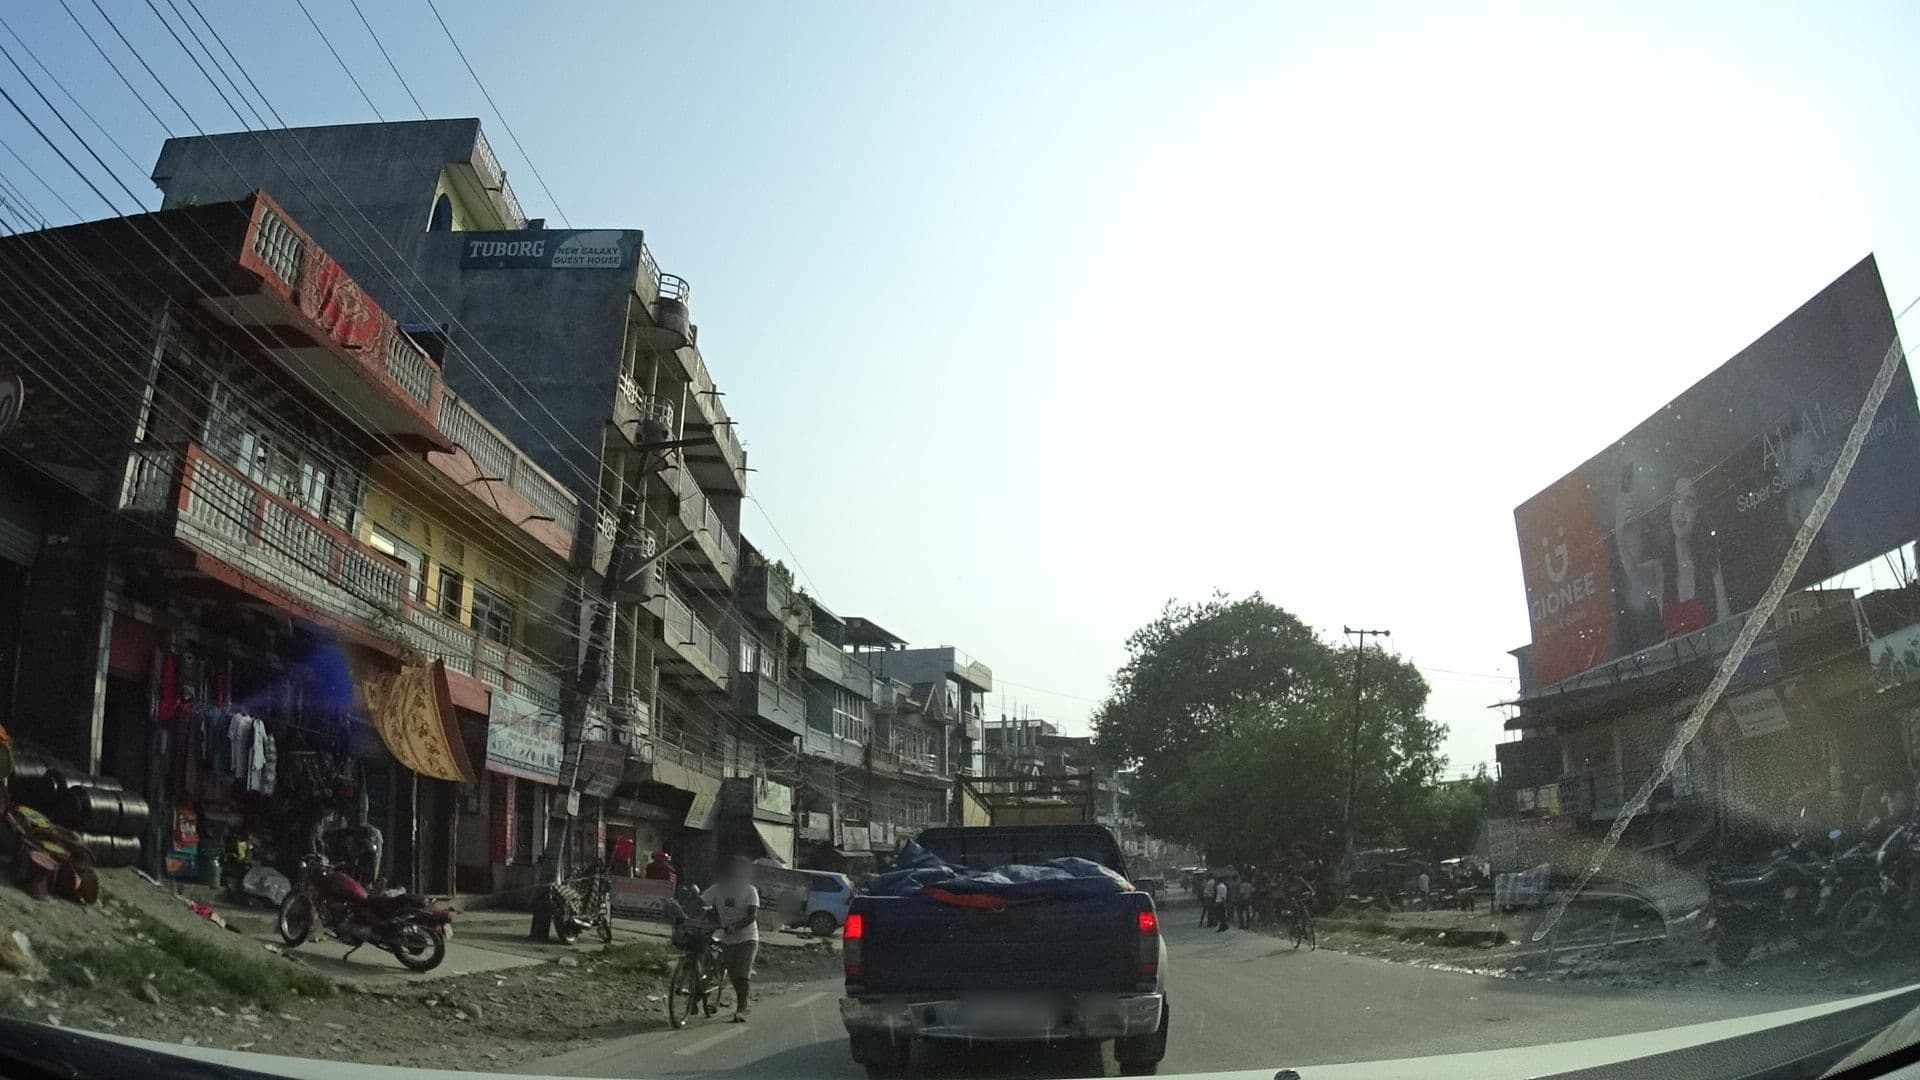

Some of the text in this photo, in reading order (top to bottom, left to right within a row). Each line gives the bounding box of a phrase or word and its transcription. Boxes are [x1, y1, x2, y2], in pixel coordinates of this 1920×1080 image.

[470, 240, 545, 258] TUBORG
[557, 247, 619, 255] NEW GALAXY
[554, 256, 620, 264] GUEST HOUSE
[1737, 484, 1770, 512] Super
[1532, 571, 1596, 622] GIONEE
